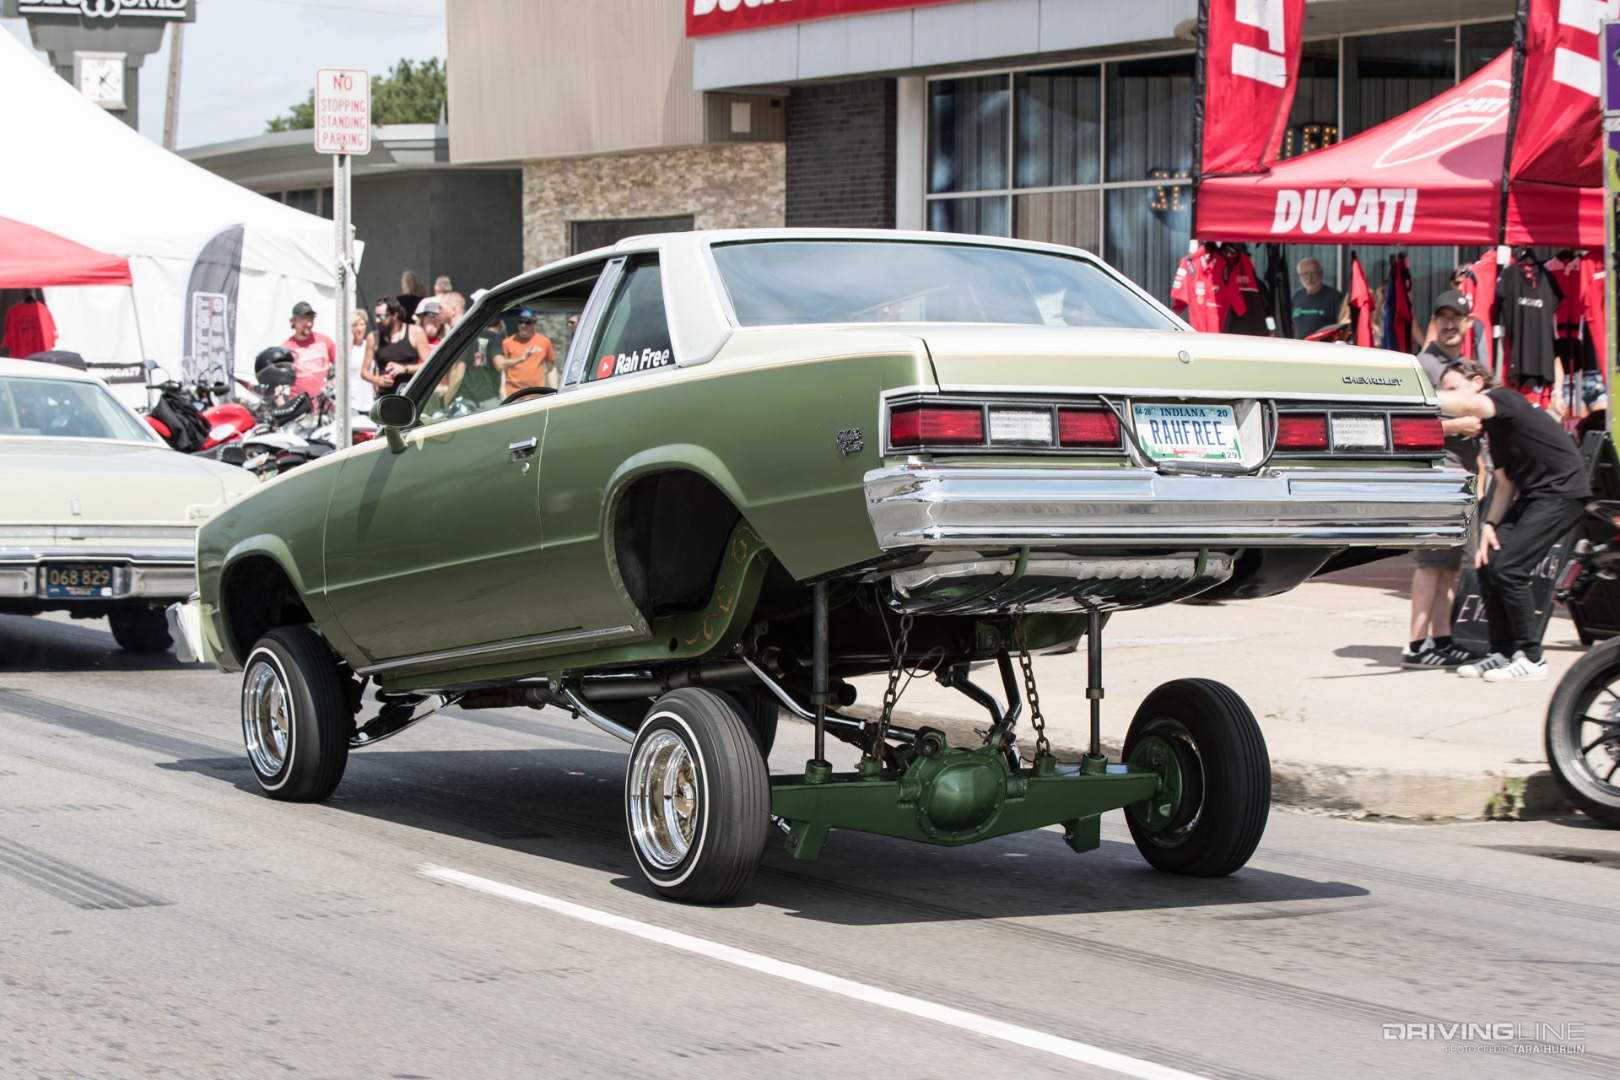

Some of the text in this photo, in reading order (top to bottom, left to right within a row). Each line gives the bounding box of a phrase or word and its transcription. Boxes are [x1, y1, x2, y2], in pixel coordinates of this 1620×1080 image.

[333, 75, 353, 91] NO
[321, 98, 366, 112] STOPPING
[321, 115, 366, 129] STANDING
[323, 132, 363, 146] PARKING
[1270, 187, 1418, 235] DUCATI
[614, 348, 670, 375] Rah Free
[1342, 375, 1402, 386] CHEVROLET
[1160, 407, 1207, 418] INDIANA
[1216, 409, 1229, 418] 20
[1149, 419, 1226, 446] RAHFREE
[1226, 451, 1238, 460] 29
[50, 569, 111, 586] 068 829
